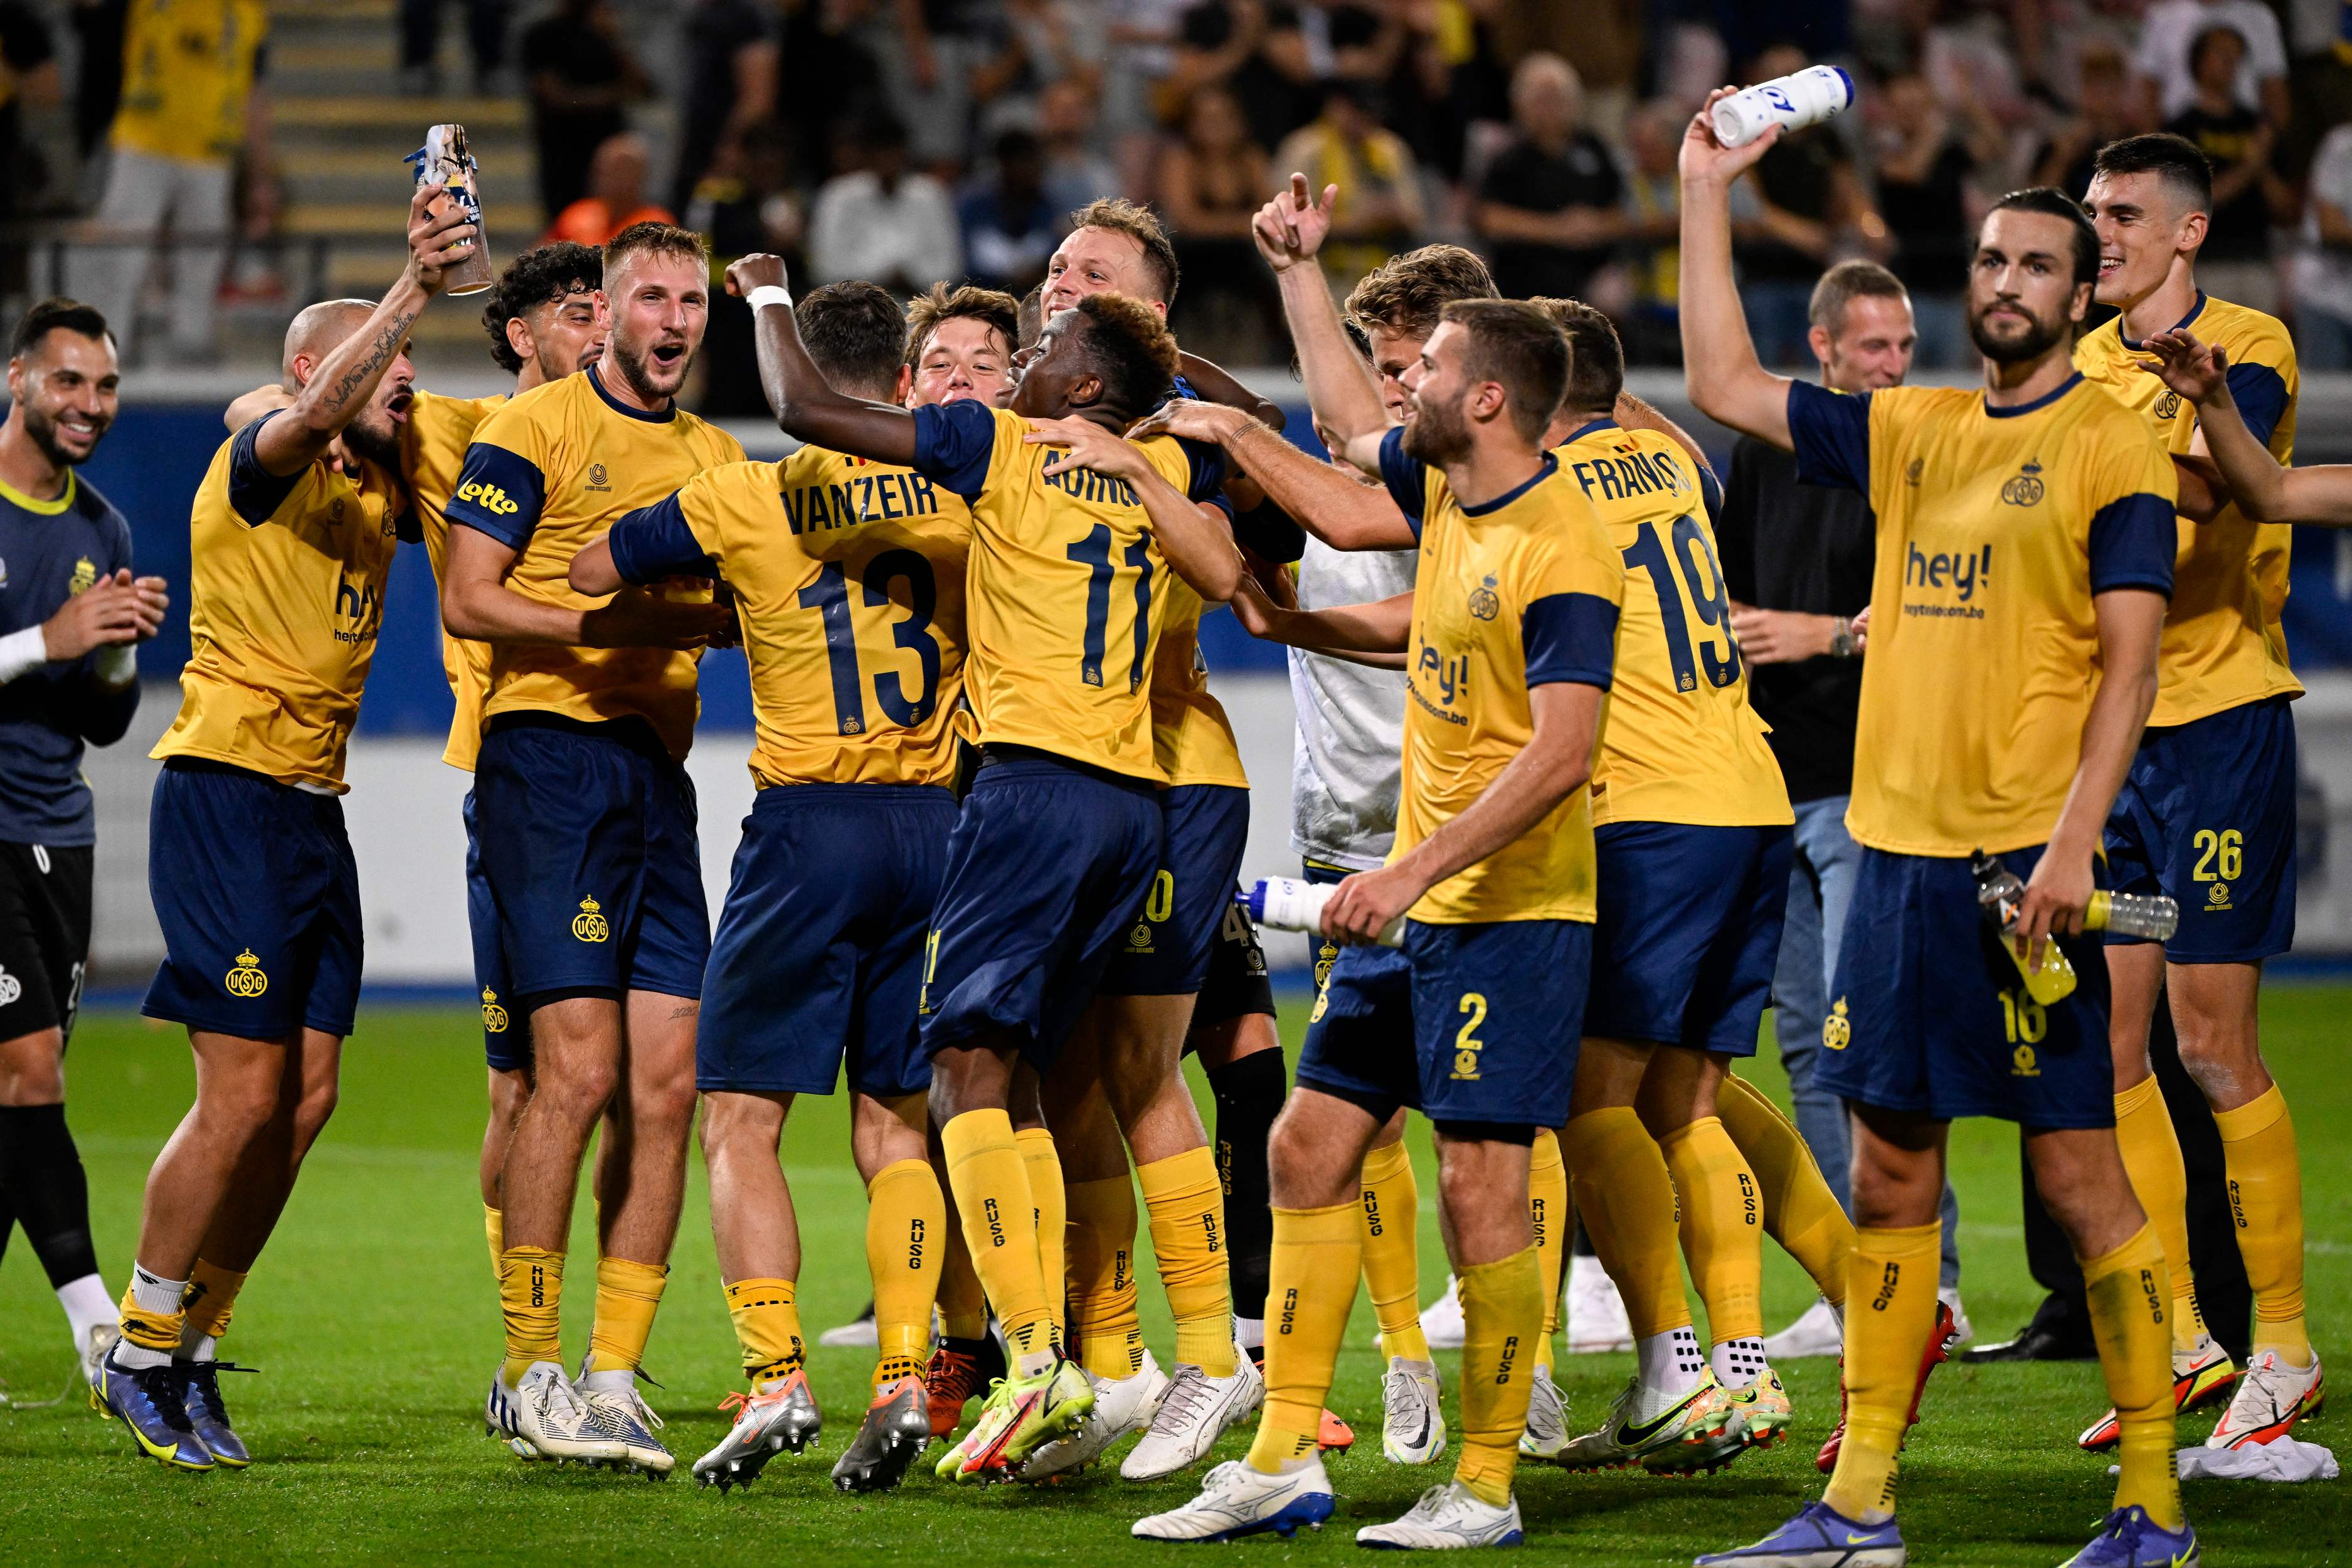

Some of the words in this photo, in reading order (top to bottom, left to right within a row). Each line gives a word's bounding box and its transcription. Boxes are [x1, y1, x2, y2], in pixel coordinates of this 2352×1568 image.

[780, 472, 938, 535] VANZEIR
[1907, 542, 1991, 601] hey!
[1067, 523, 1153, 697] 11
[1623, 514, 1740, 693] 19
[798, 549, 941, 736] 13
[2193, 829, 2243, 881] 26
[1138, 869, 1173, 923] 0
[1455, 992, 1487, 1051] 2
[983, 1197, 1005, 1248] RUSG
[1364, 1190, 1383, 1236] RUSG
[1532, 1198, 1545, 1248] RUSG
[1737, 1173, 1756, 1225] RUSG
[2229, 1179, 2248, 1228] RUSG
[909, 1219, 924, 1269] RUSG
[1202, 1213, 1219, 1253] RUSG
[531, 1264, 544, 1307] RUSG
[1114, 1250, 1126, 1290] RUSG
[1872, 1262, 1900, 1311] RUSG
[1279, 1288, 1298, 1335] RUSG
[2140, 1269, 2163, 1325] RUSG
[1495, 1336, 1519, 1385] RUSG
